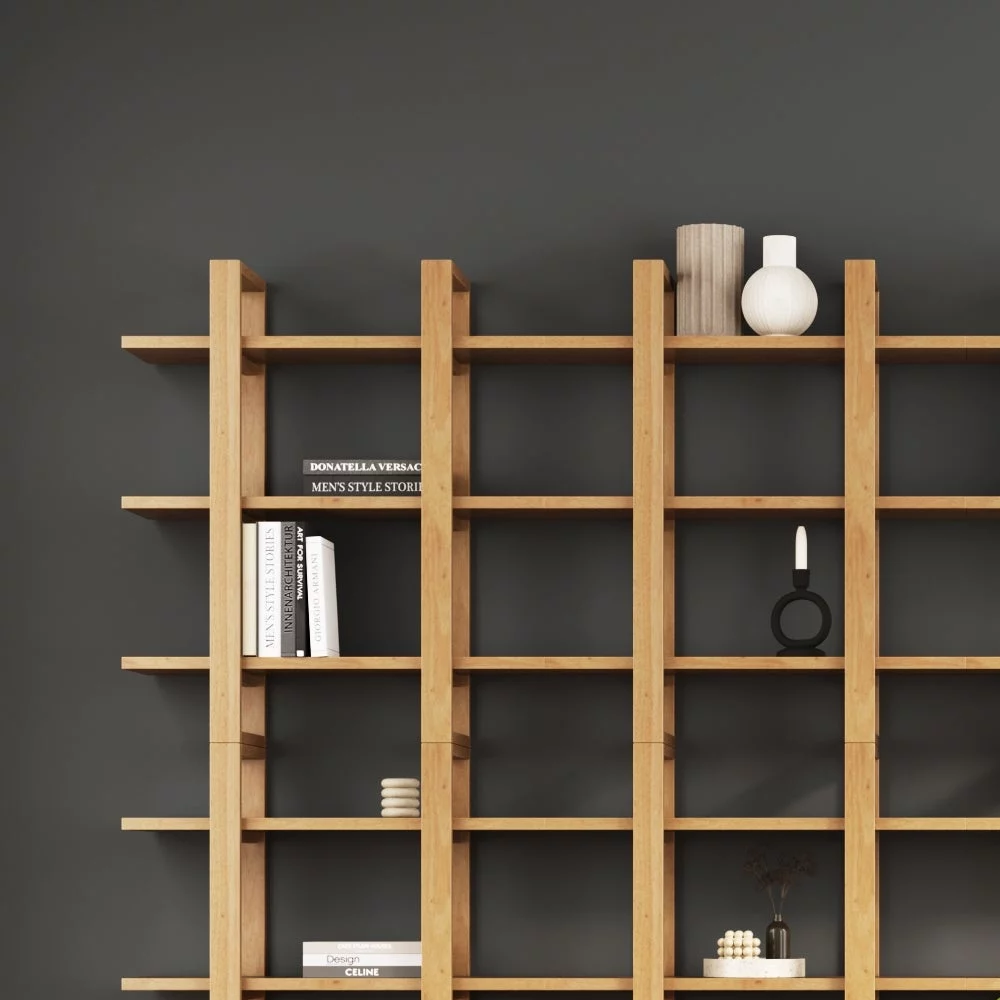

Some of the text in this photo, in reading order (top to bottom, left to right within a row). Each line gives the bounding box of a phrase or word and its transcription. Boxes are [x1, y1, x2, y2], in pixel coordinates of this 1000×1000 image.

[310, 462, 421, 472] DONATELLA VERSAC
[311, 482, 345, 492] MEN'S
[347, 482, 382, 492] STYLE
[264, 528, 275, 575] STORIES
[284, 525, 293, 633] INNENARCHITEKTUR
[264, 577, 275, 612] STYLE
[326, 955, 360, 966] Design
[345, 968, 379, 976] CELINE
